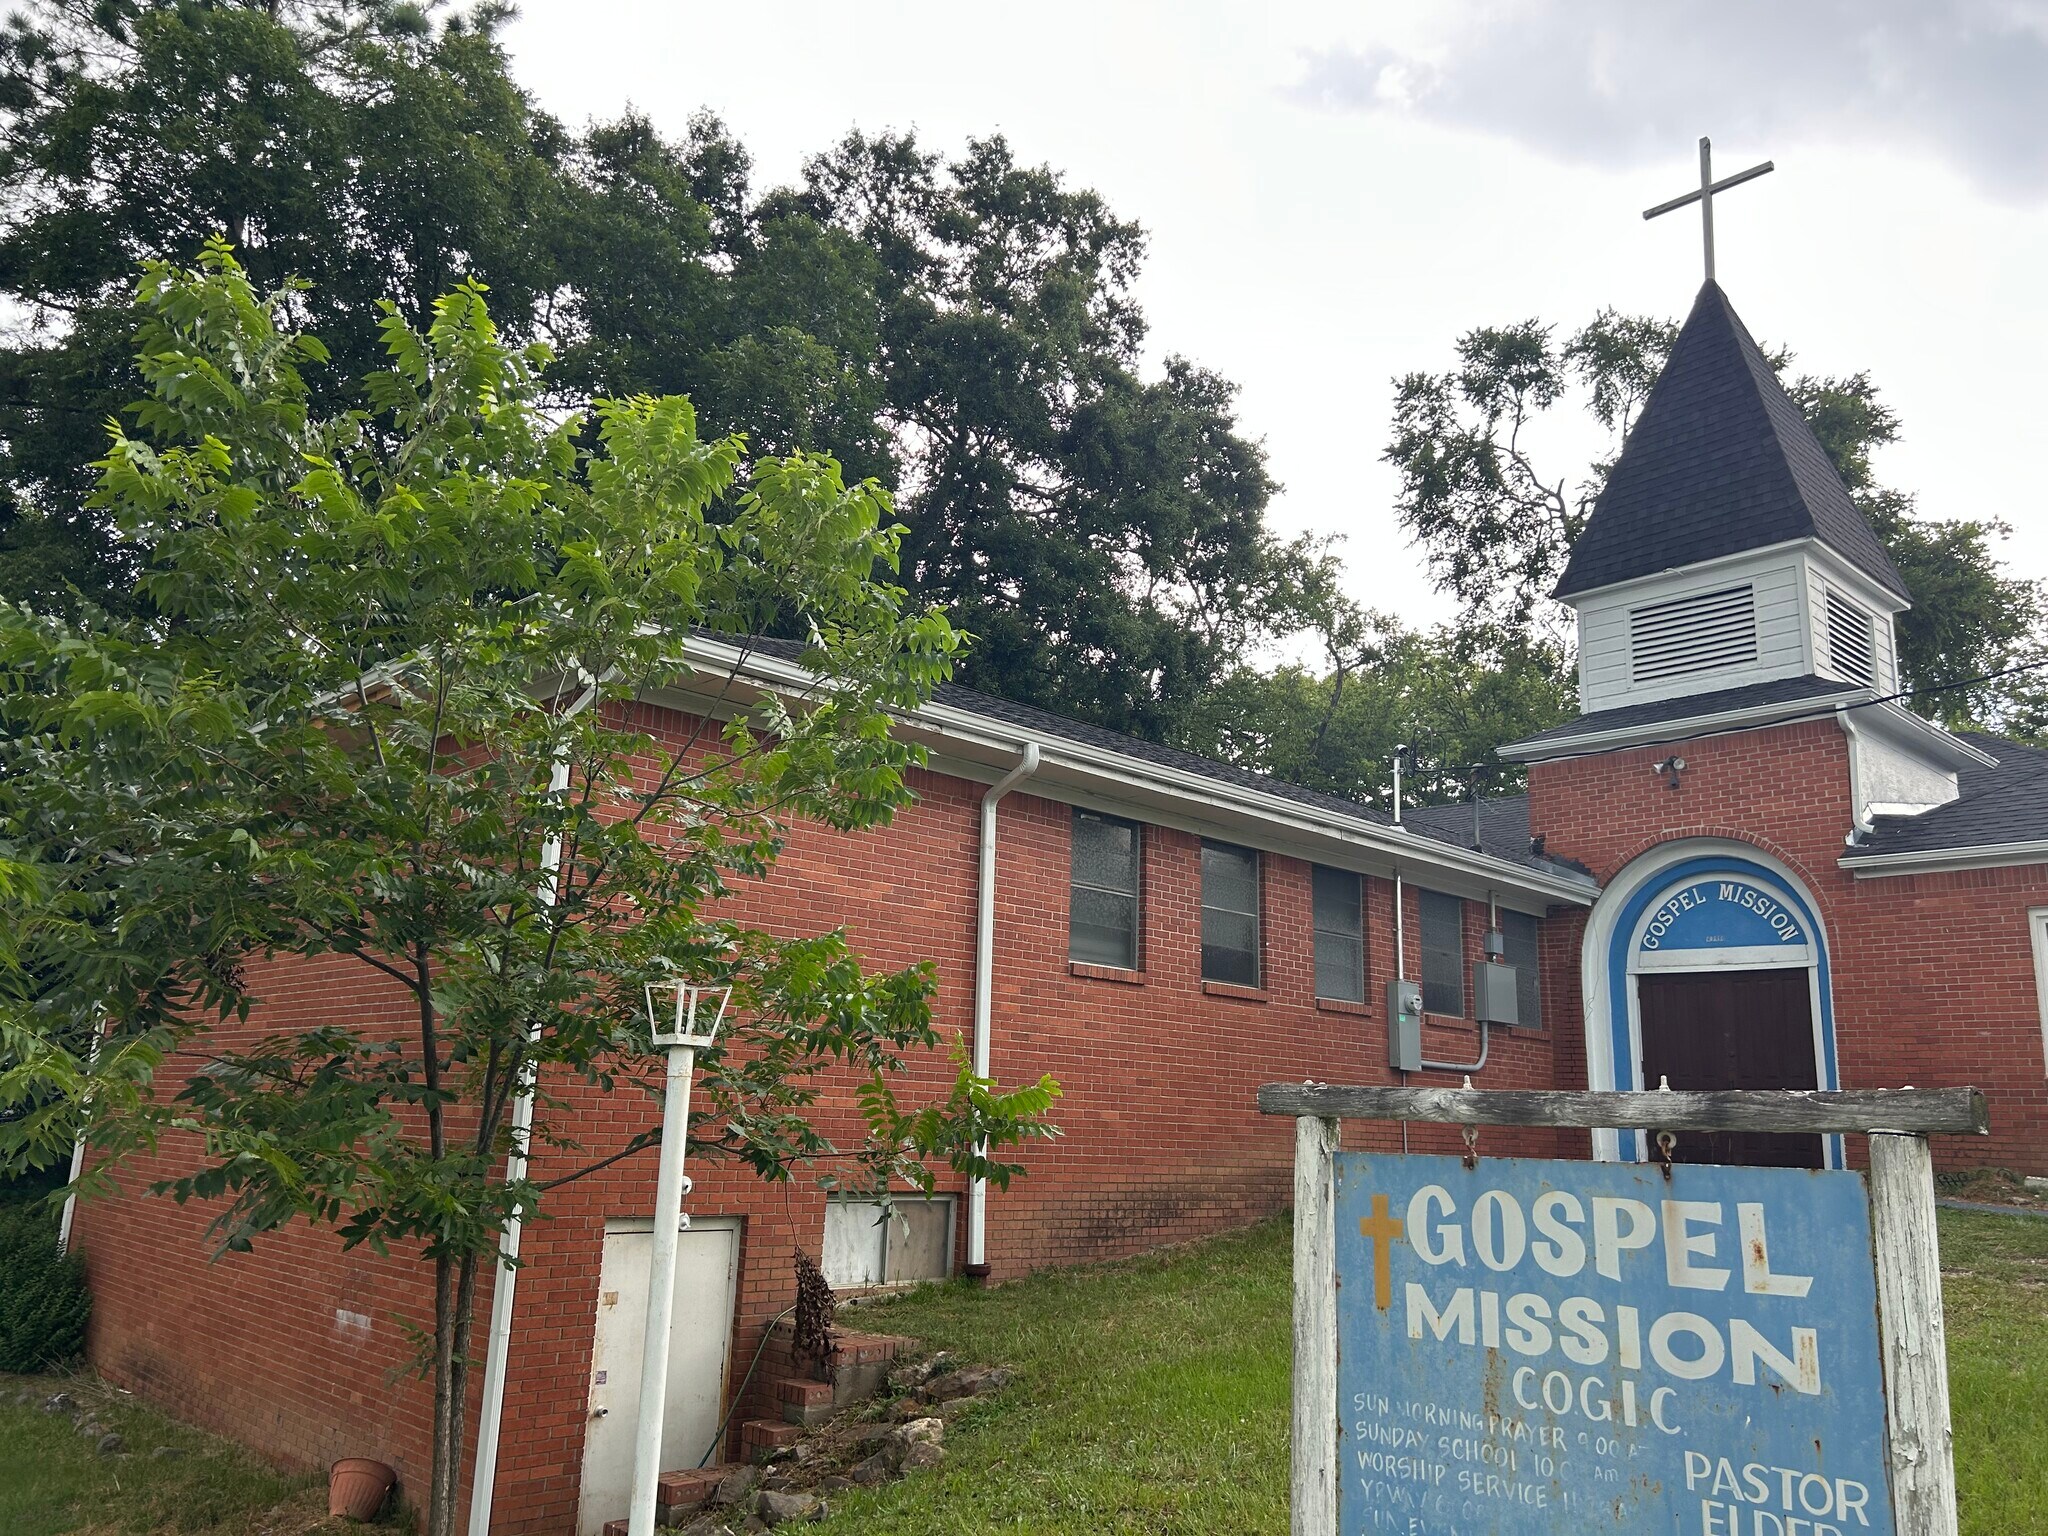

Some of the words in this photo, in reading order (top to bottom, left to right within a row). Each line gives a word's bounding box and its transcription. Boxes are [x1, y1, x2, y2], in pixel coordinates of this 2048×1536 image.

[1642, 887, 1707, 950] GOSPEL
[1718, 883, 1799, 942] MISSION
[1406, 1184, 1814, 1298] GOSPEL
[1405, 1282, 1822, 1396] MISSION
[1353, 1392, 1390, 1417] SUN
[1489, 1415, 1568, 1452] PRAYER
[1355, 1420, 1430, 1452] SUNDAY
[1357, 1450, 1446, 1487] WORSHIP
[1458, 1470, 1548, 1510] SERVICE
[1684, 1450, 1870, 1527] PASTOR
